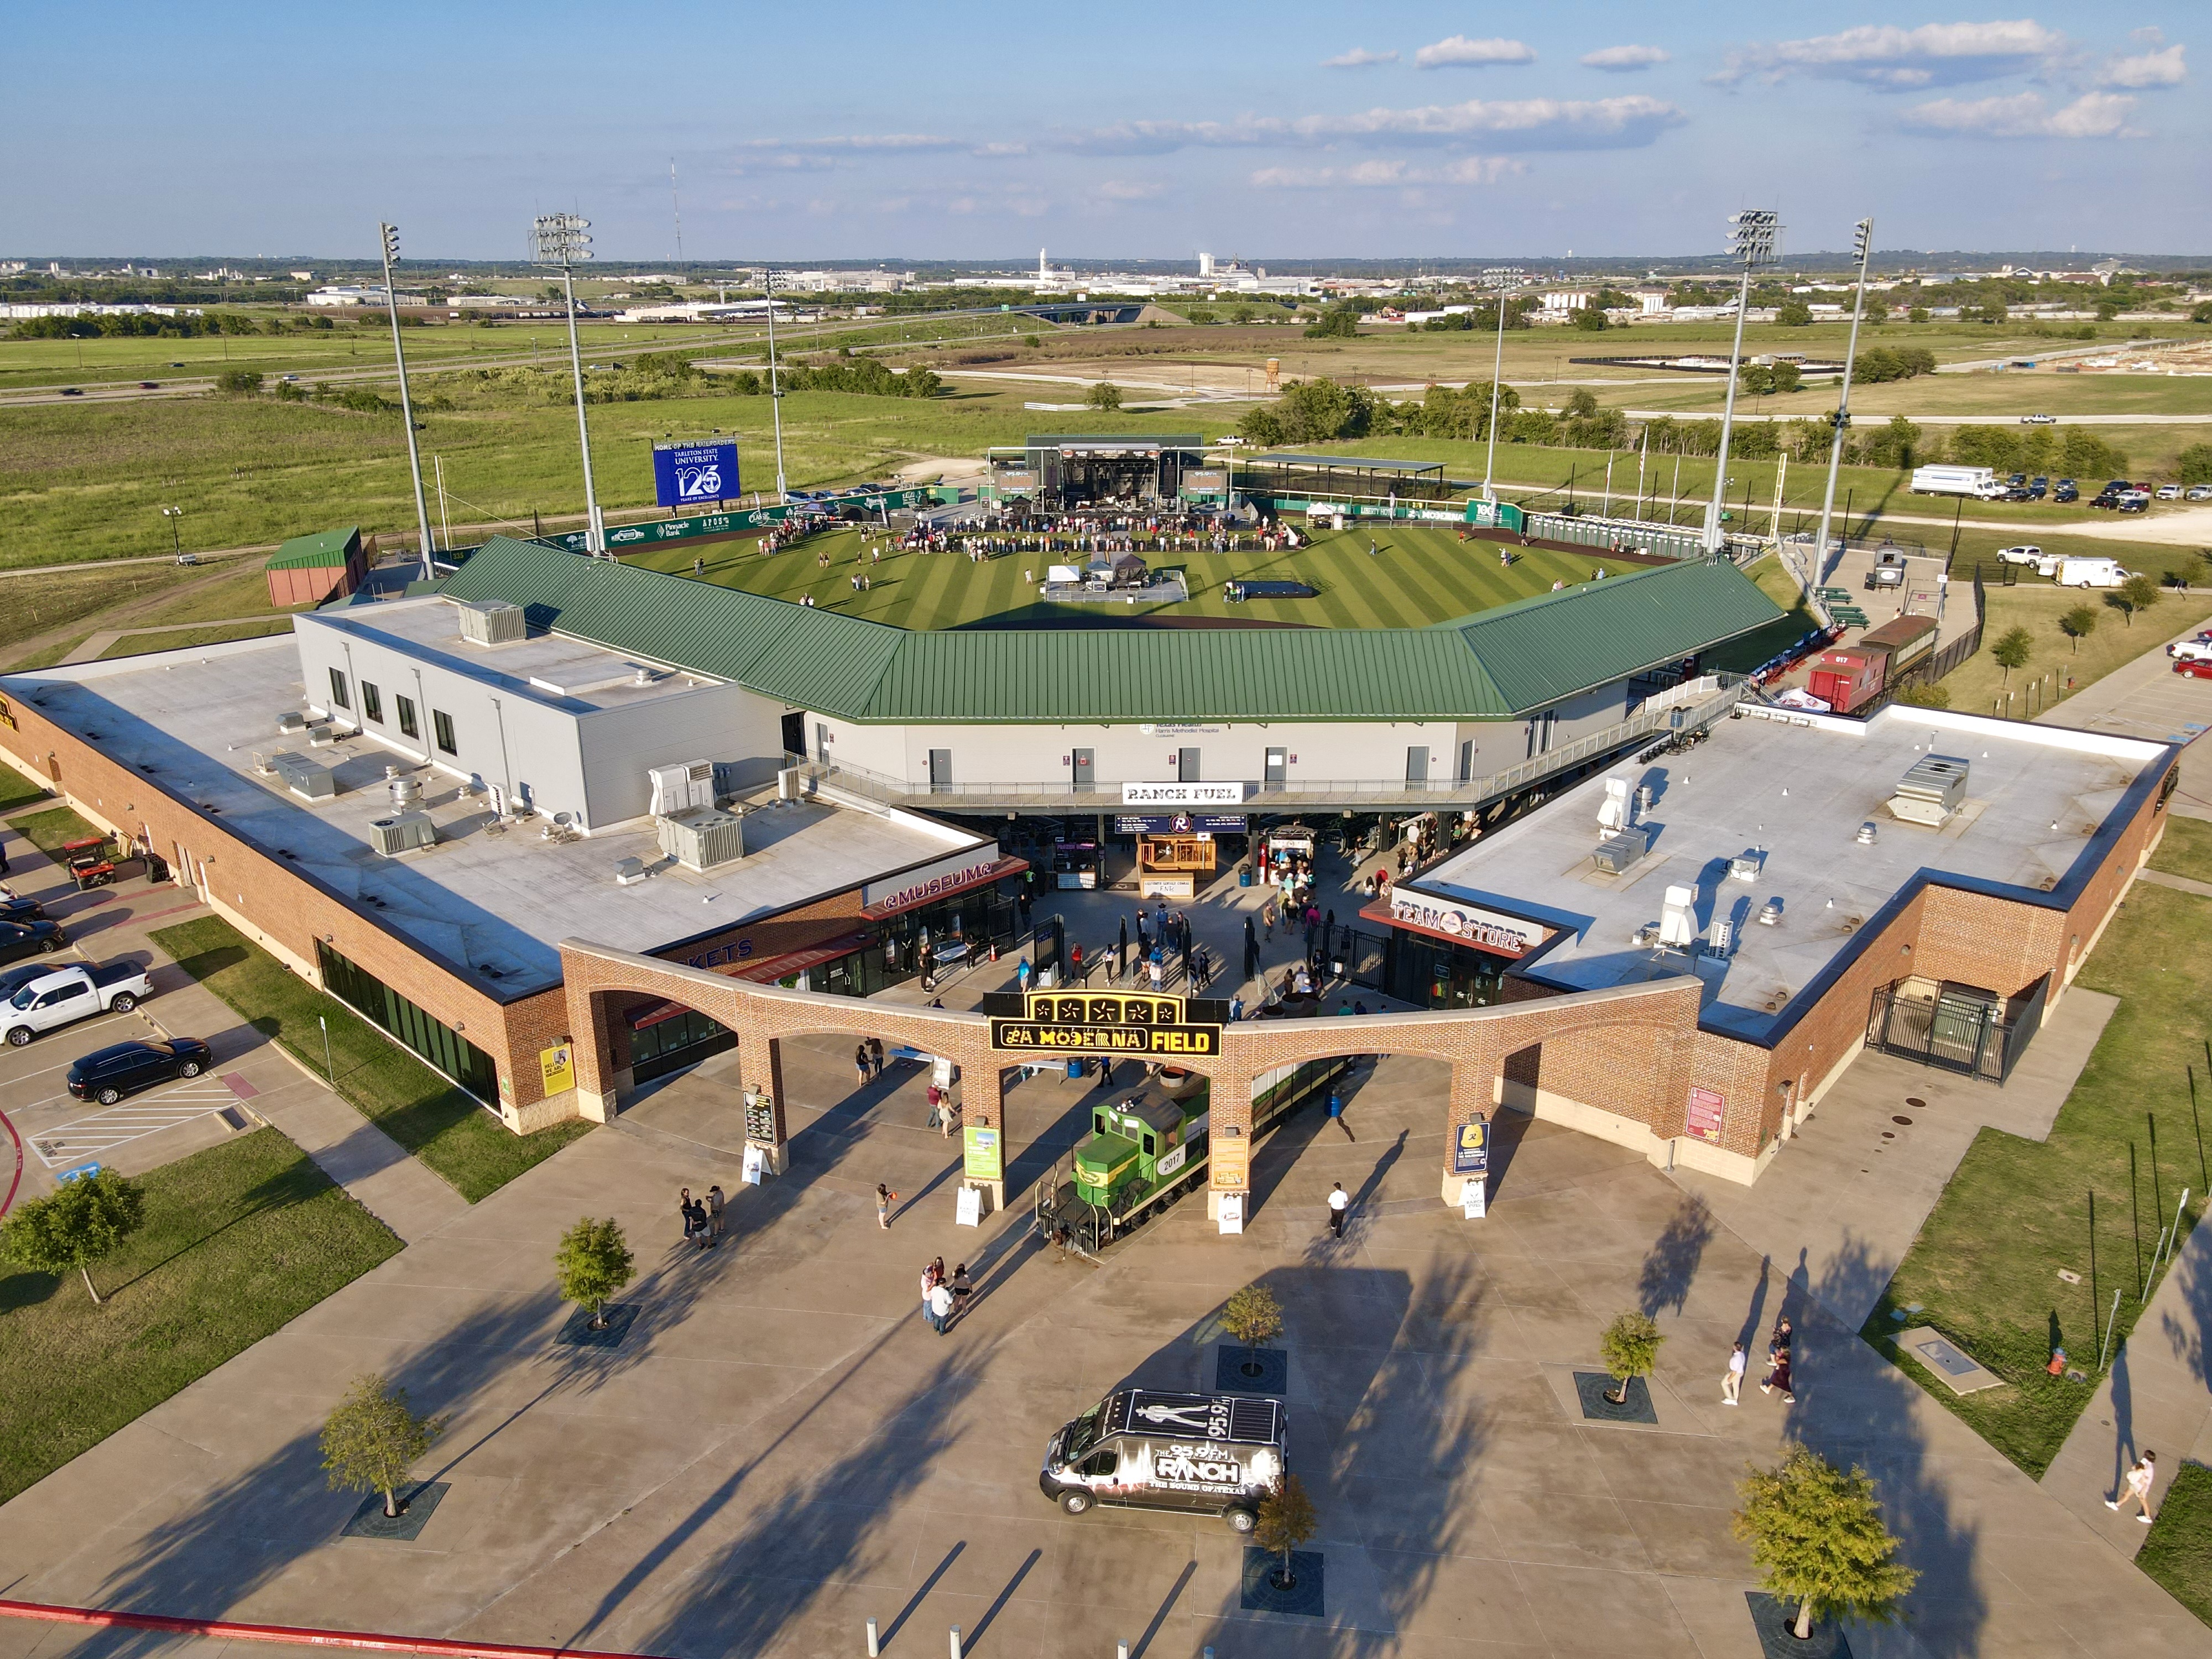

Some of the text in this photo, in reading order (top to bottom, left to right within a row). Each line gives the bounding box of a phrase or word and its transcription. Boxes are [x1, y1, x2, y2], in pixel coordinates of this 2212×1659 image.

[696, 439, 735, 447] RAILROADERS
[675, 465, 721, 497] 125
[665, 521, 690, 530] Pinnacle
[1128, 789, 1236, 799] RANCH FUEL
[897, 865, 983, 906] MUSEUM
[1390, 902, 1439, 929] TEAM
[1462, 921, 1522, 952] STORE
[676, 938, 753, 969] KETS
[1006, 1031, 1209, 1052] LA MODERNA FIELD
[1164, 1153, 1180, 1171] 2017
[1208, 1404, 1228, 1437] 95.9
[1170, 1445, 1209, 1457] 95.9
[1210, 1450, 1228, 1459] FM
[1157, 1458, 1238, 1482] RANCH
[1170, 1481, 1199, 1491] SOUND
[1216, 1486, 1246, 1495] TEXAS
